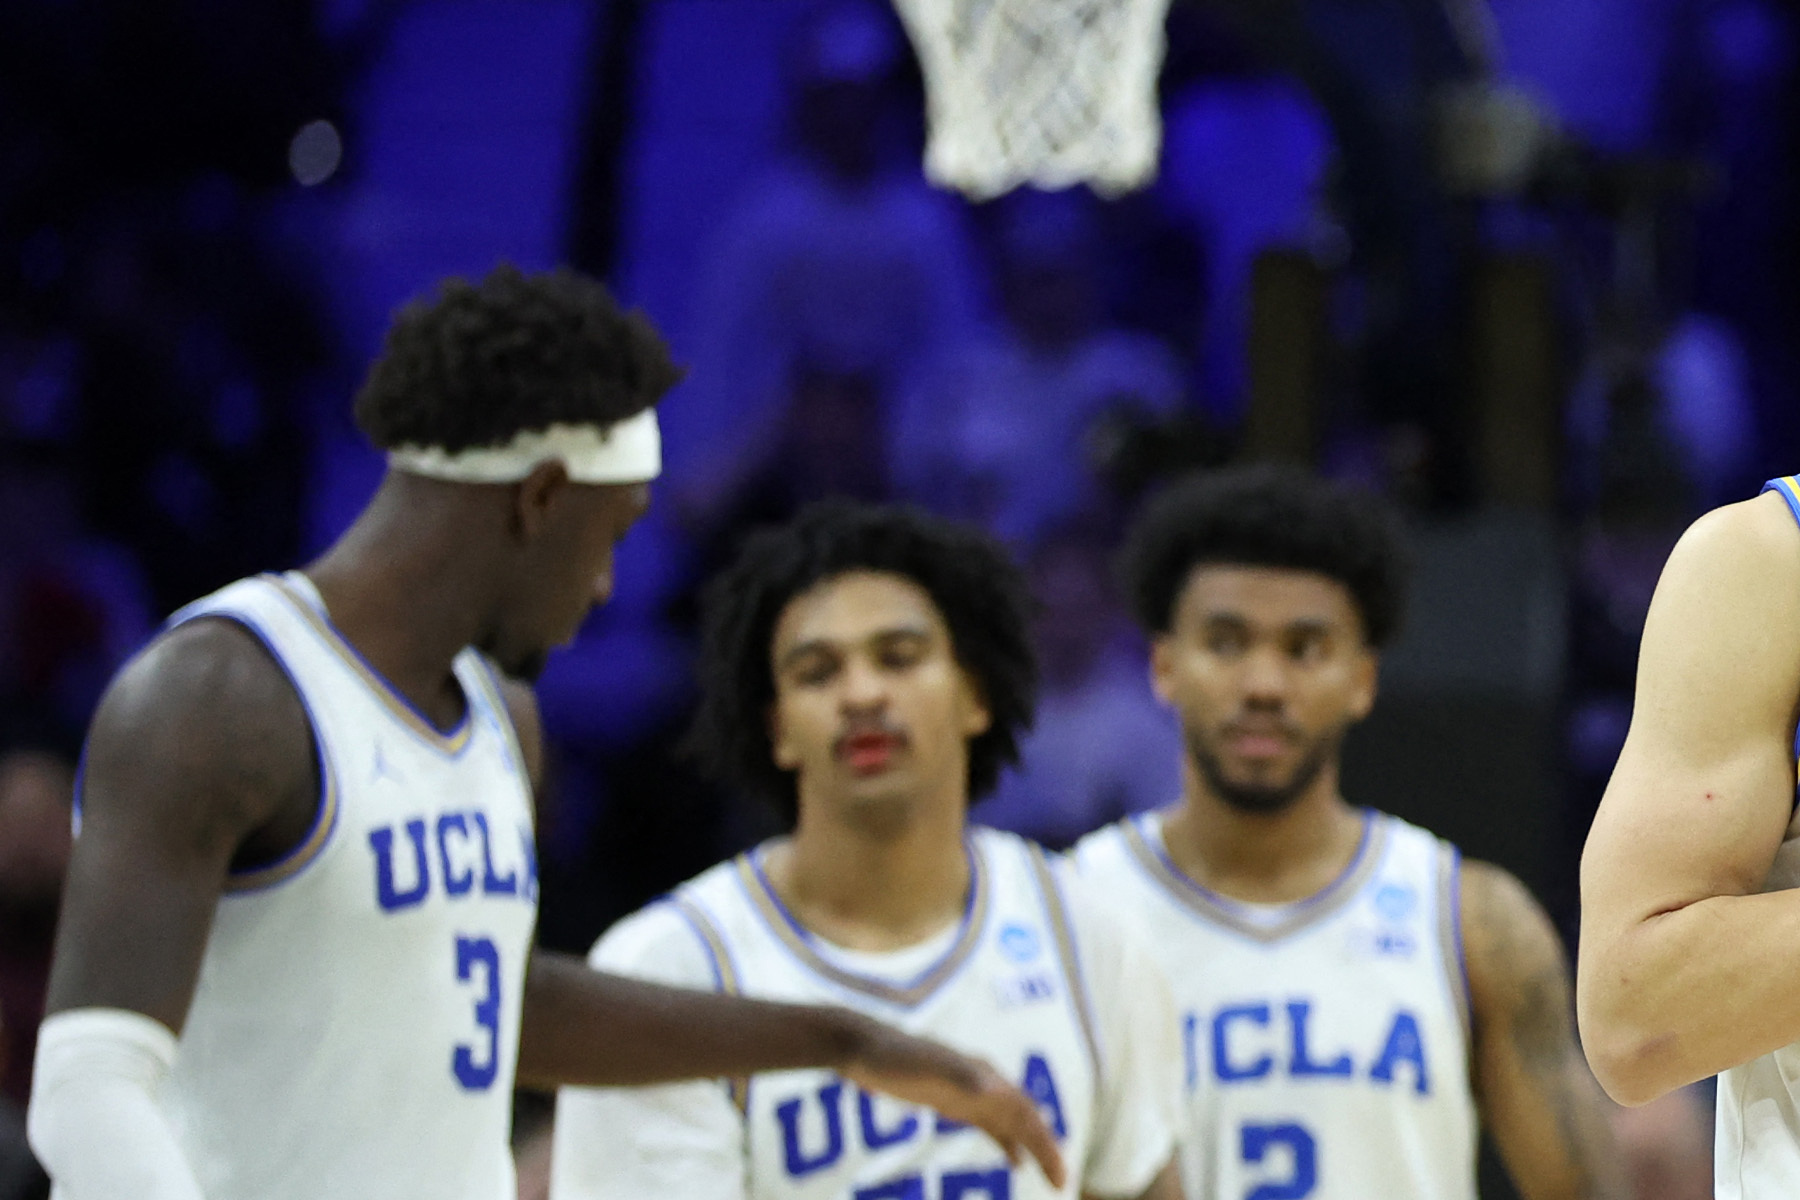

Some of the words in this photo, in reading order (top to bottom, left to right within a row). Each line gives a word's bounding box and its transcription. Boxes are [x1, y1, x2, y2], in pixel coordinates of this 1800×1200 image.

[453, 936, 500, 1091] 3
[1184, 1000, 1431, 1096] CLA
[776, 1052, 1068, 1177] UCA
